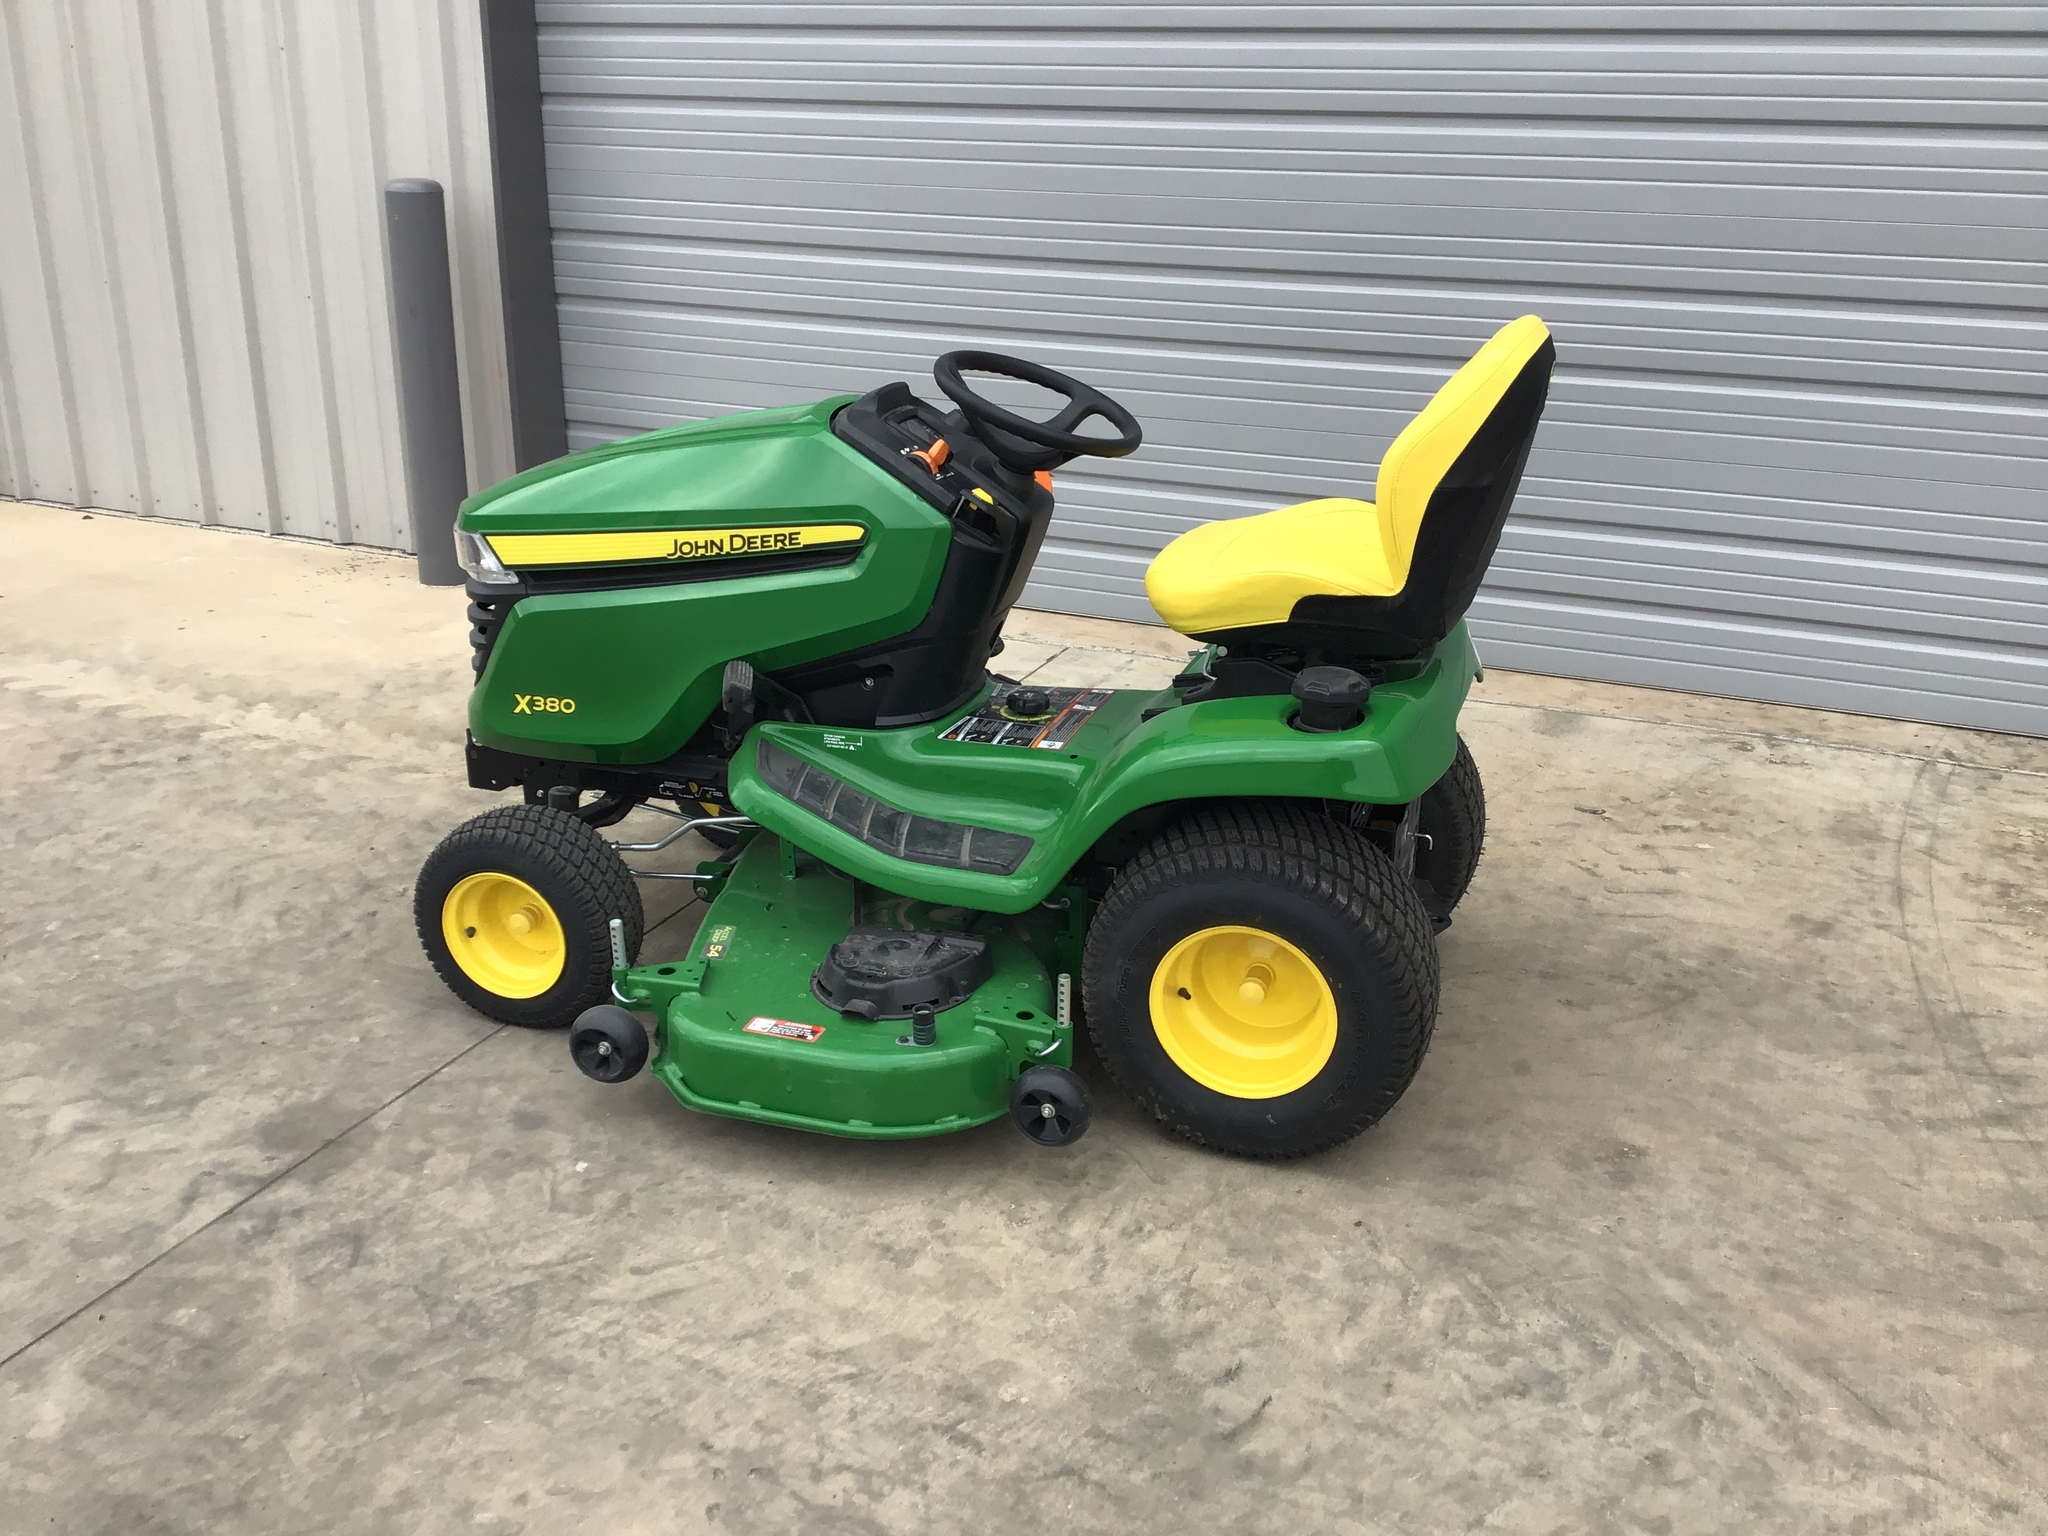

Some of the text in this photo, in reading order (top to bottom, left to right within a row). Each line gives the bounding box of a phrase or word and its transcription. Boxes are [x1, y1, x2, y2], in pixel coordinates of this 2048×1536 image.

[667, 531, 802, 559] JOHN DEERE
[512, 693, 576, 715] X380
[706, 944, 723, 957] 54
